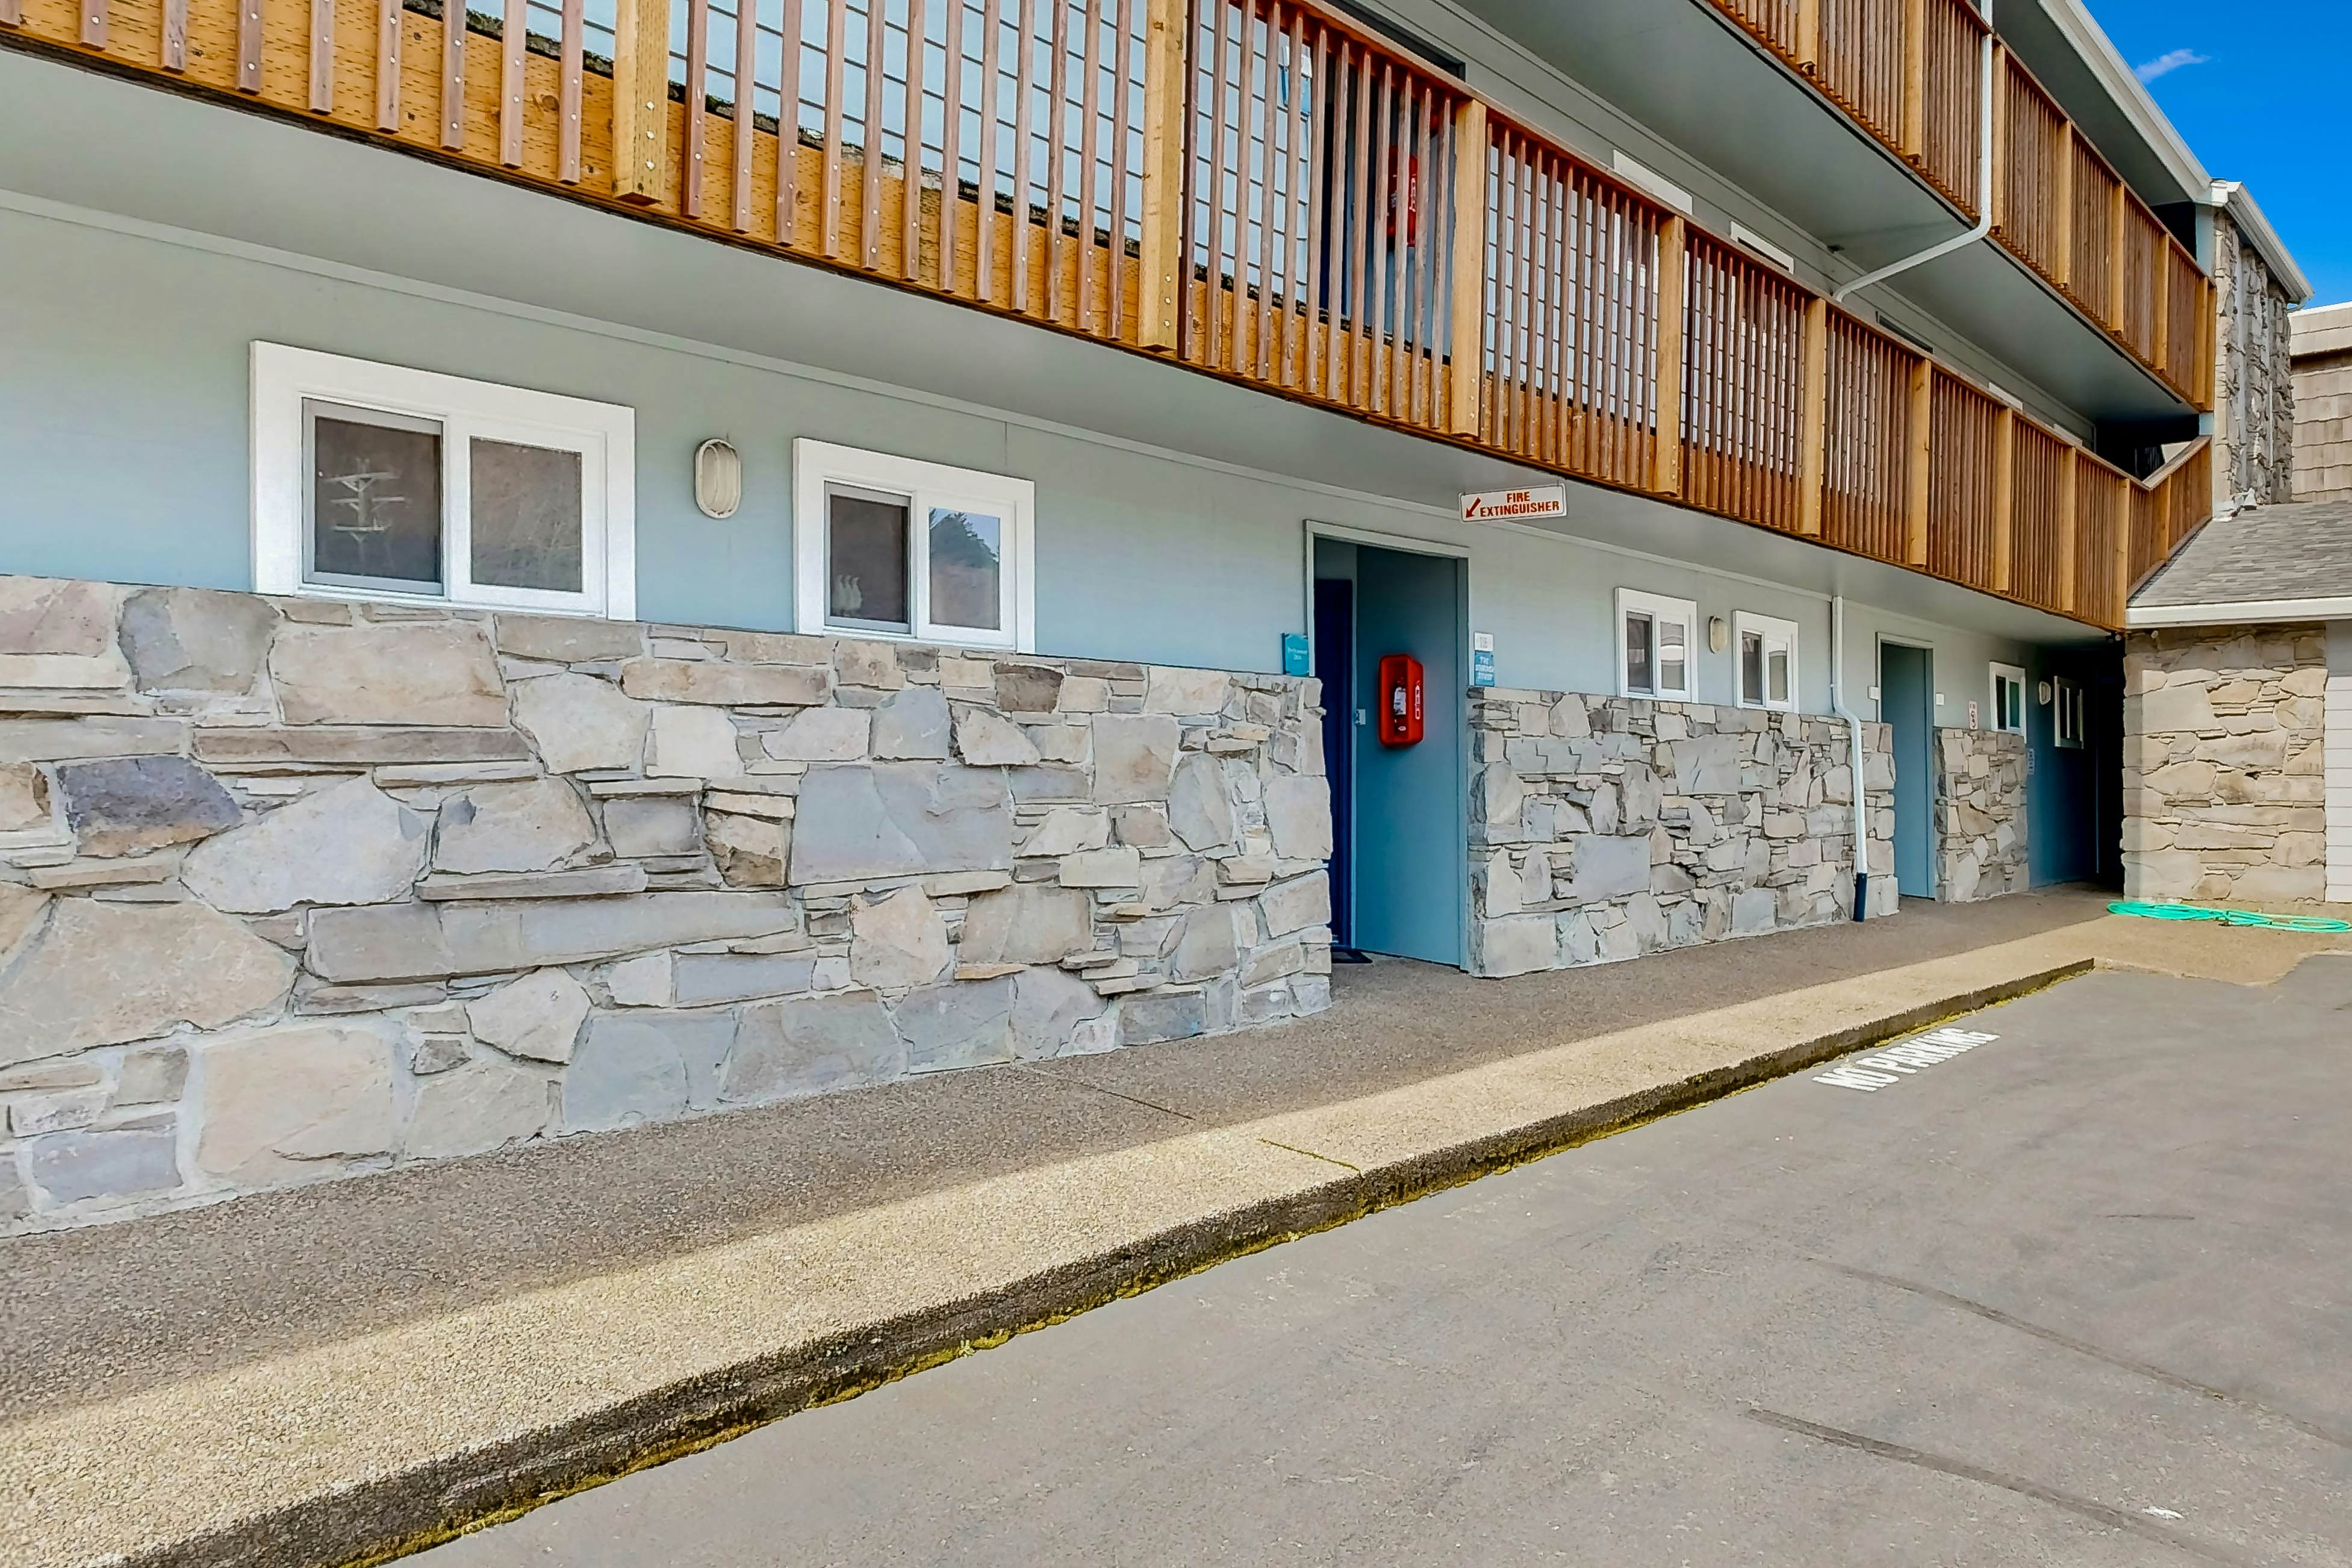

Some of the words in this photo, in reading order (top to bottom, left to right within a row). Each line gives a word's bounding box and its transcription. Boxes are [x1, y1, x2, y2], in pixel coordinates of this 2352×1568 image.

[1507, 491, 1530, 503] FIRE
[1479, 500, 1560, 517] EXTINGUISHER
[1811, 1066, 1900, 1092] NO
[1856, 1027, 2001, 1074] PARKING
